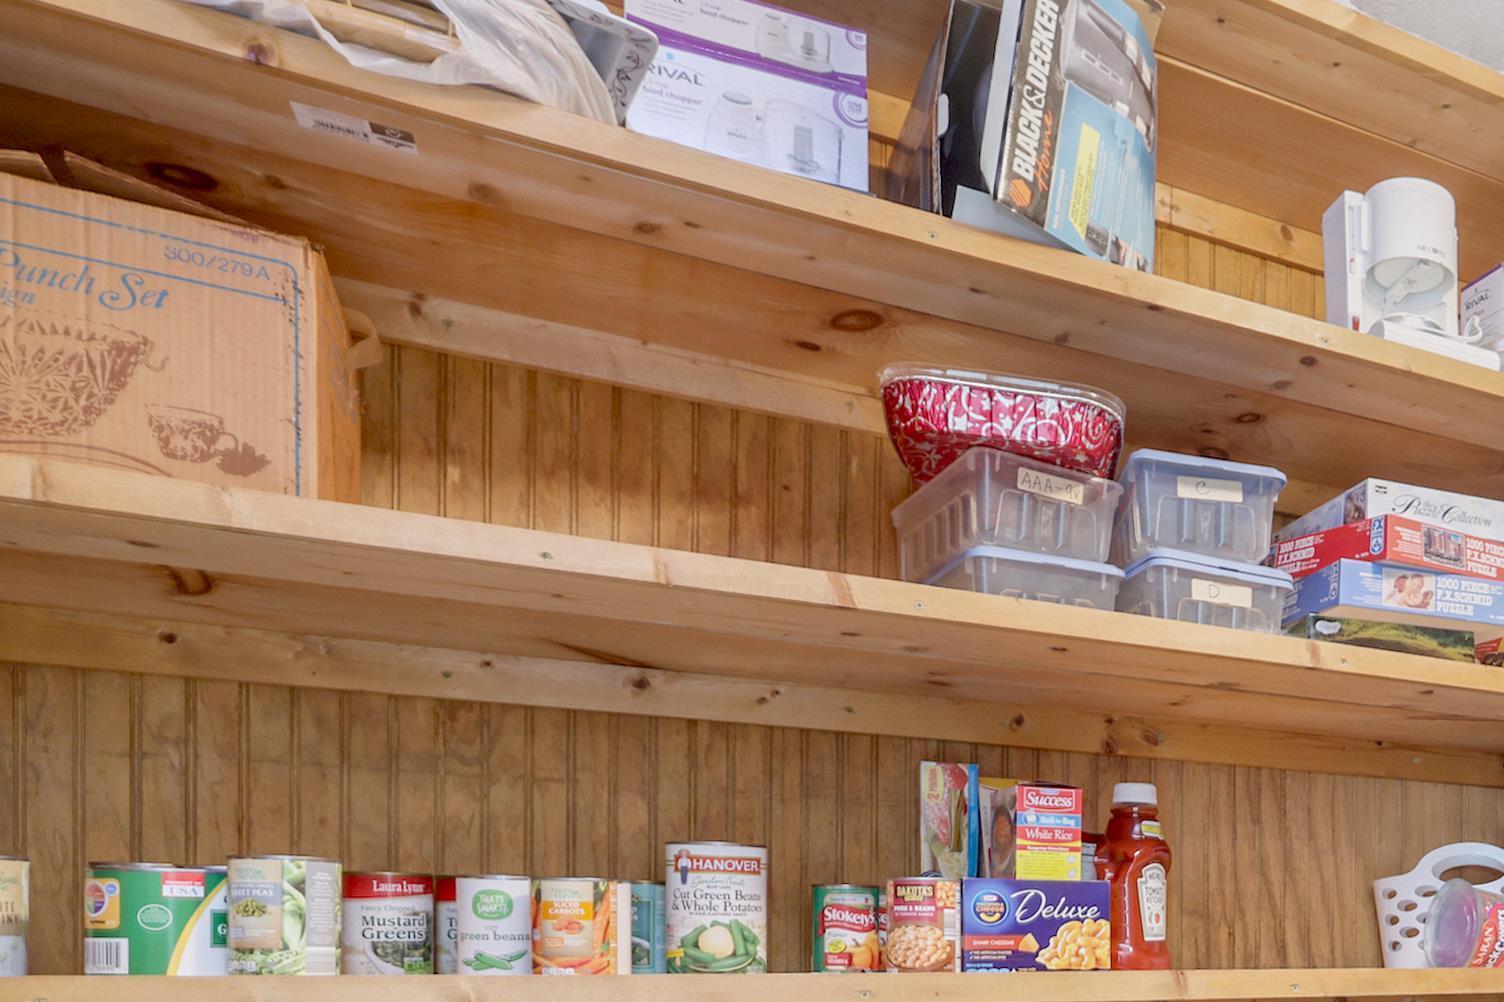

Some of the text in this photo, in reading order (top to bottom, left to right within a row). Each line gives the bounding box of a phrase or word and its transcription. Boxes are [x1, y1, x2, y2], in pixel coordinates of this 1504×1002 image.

[647, 62, 705, 88] RIVAL
[1034, 111, 1054, 192] Home
[99, 273, 171, 311] Set
[1465, 292, 1490, 311] RIVAL
[1195, 481, 1211, 496] C
[1208, 584, 1221, 599] D
[1026, 791, 1073, 807] Success
[1025, 828, 1073, 841] White Rice
[691, 859, 759, 872] HANOVER
[169, 885, 199, 896] USA
[251, 889, 274, 898] PEAS
[372, 880, 426, 895] Laura Lynn
[672, 888, 761, 901] Cut Green Beans
[671, 900, 763, 912] & Whole Potatoes
[1010, 888, 1101, 924] Deluxe
[361, 914, 427, 927] Mustard
[823, 906, 876, 926] Stokely's
[361, 927, 425, 941] Greens
[460, 929, 531, 942] green beans
[1473, 927, 1495, 965] SARAN
